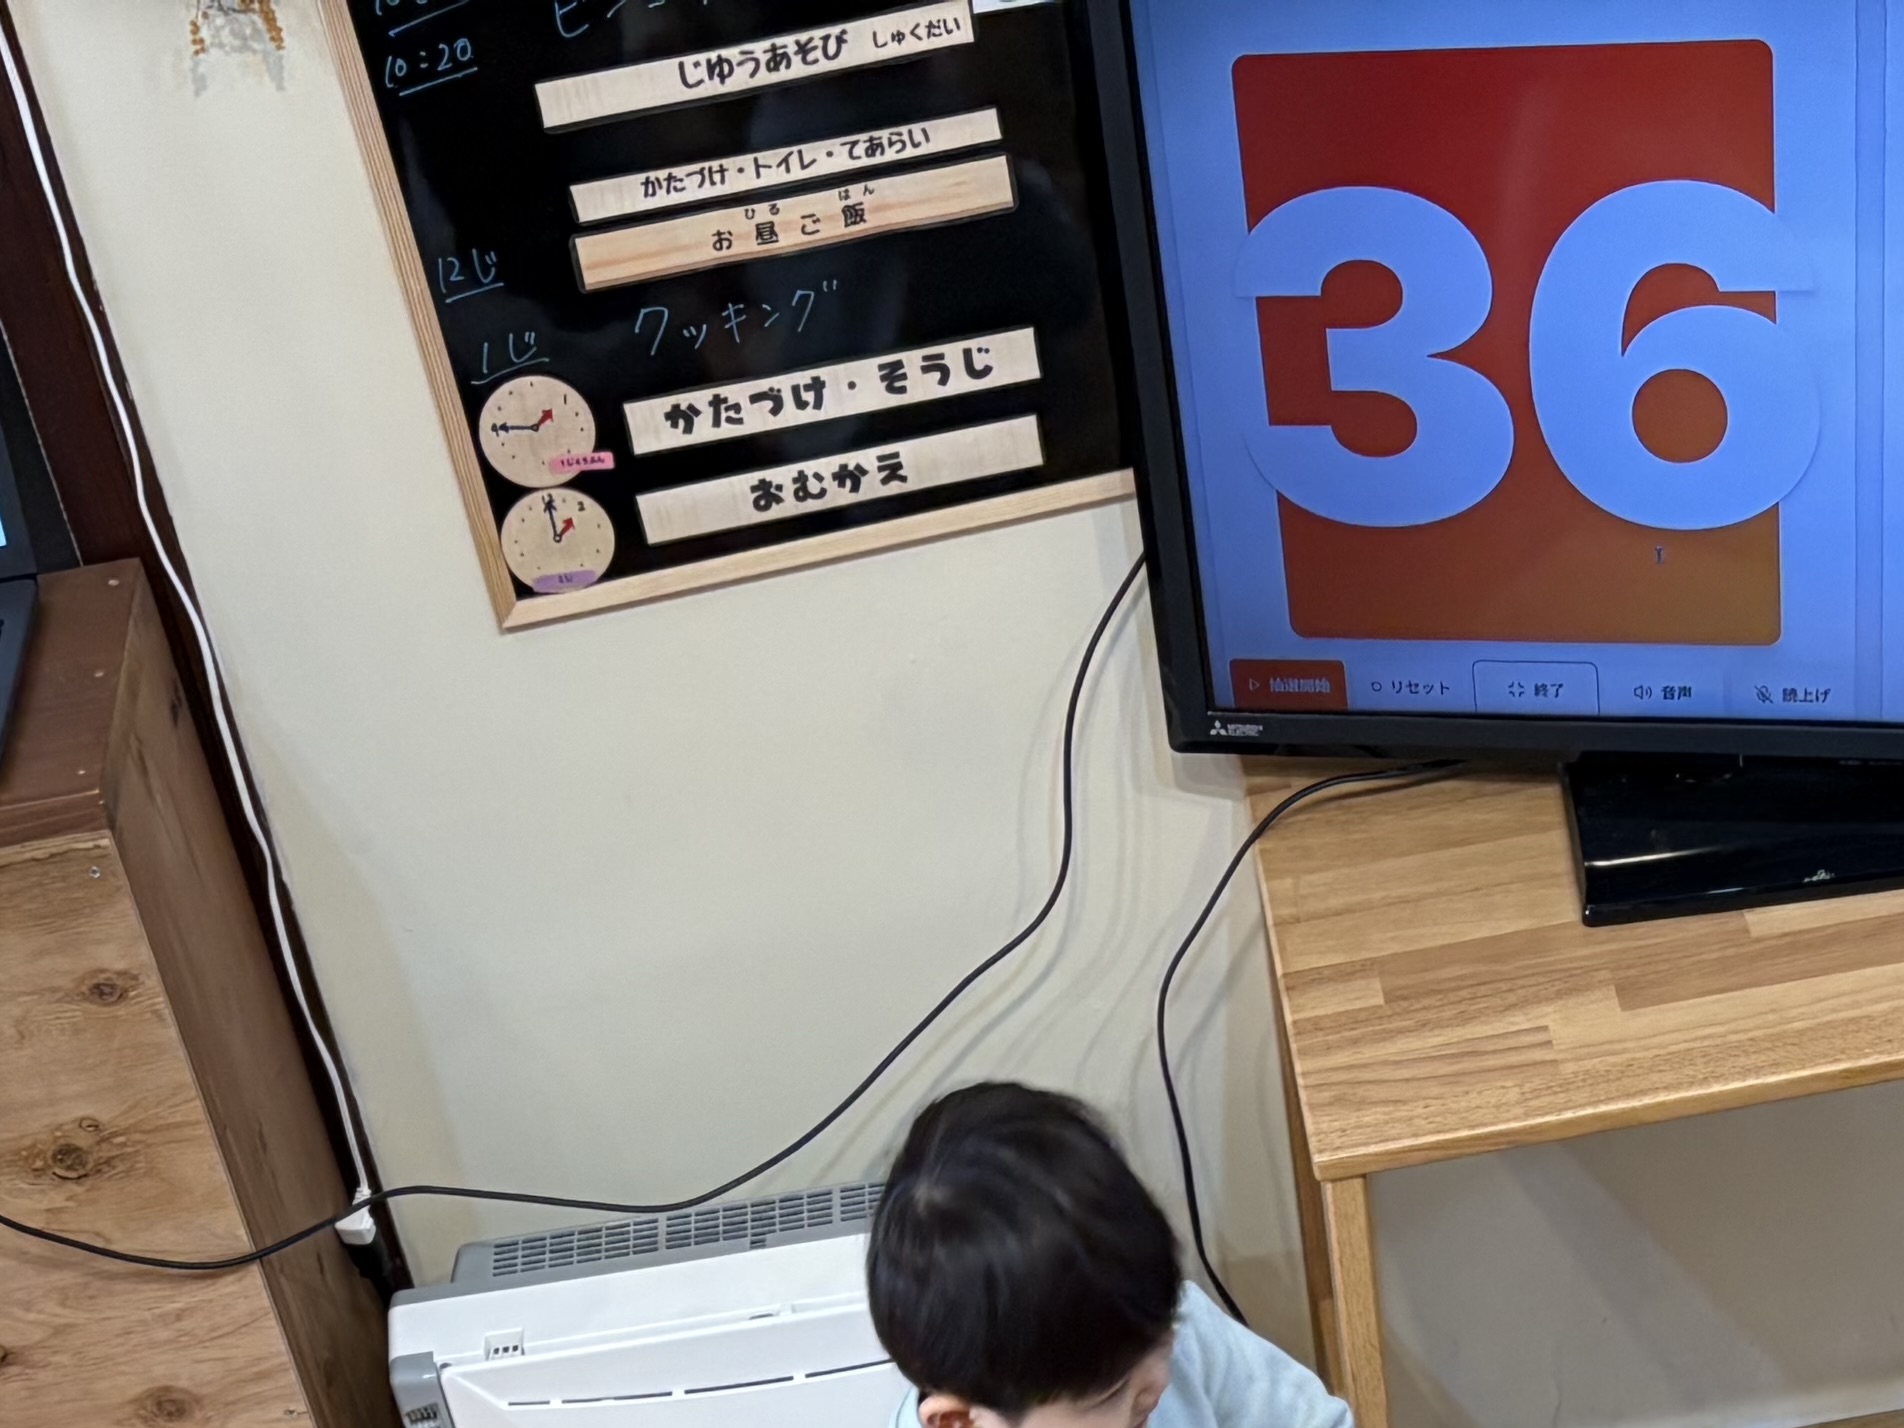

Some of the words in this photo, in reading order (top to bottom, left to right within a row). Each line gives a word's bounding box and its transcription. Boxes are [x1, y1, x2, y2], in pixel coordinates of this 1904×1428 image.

[678, 28, 848, 89] じゆうあそび
[872, 17, 962, 49] しゅくだい
[711, 201, 868, 252] お昼ご飯
[744, 203, 781, 220] ひる
[838, 183, 875, 201] はん
[1233, 178, 1821, 531] 36
[662, 345, 994, 435] かたづけ・そうじ
[749, 449, 909, 513] おむかえ
[1391, 679, 1451, 697] リセット
[1533, 682, 1565, 699] 終了
[1660, 684, 1693, 702] 音声
